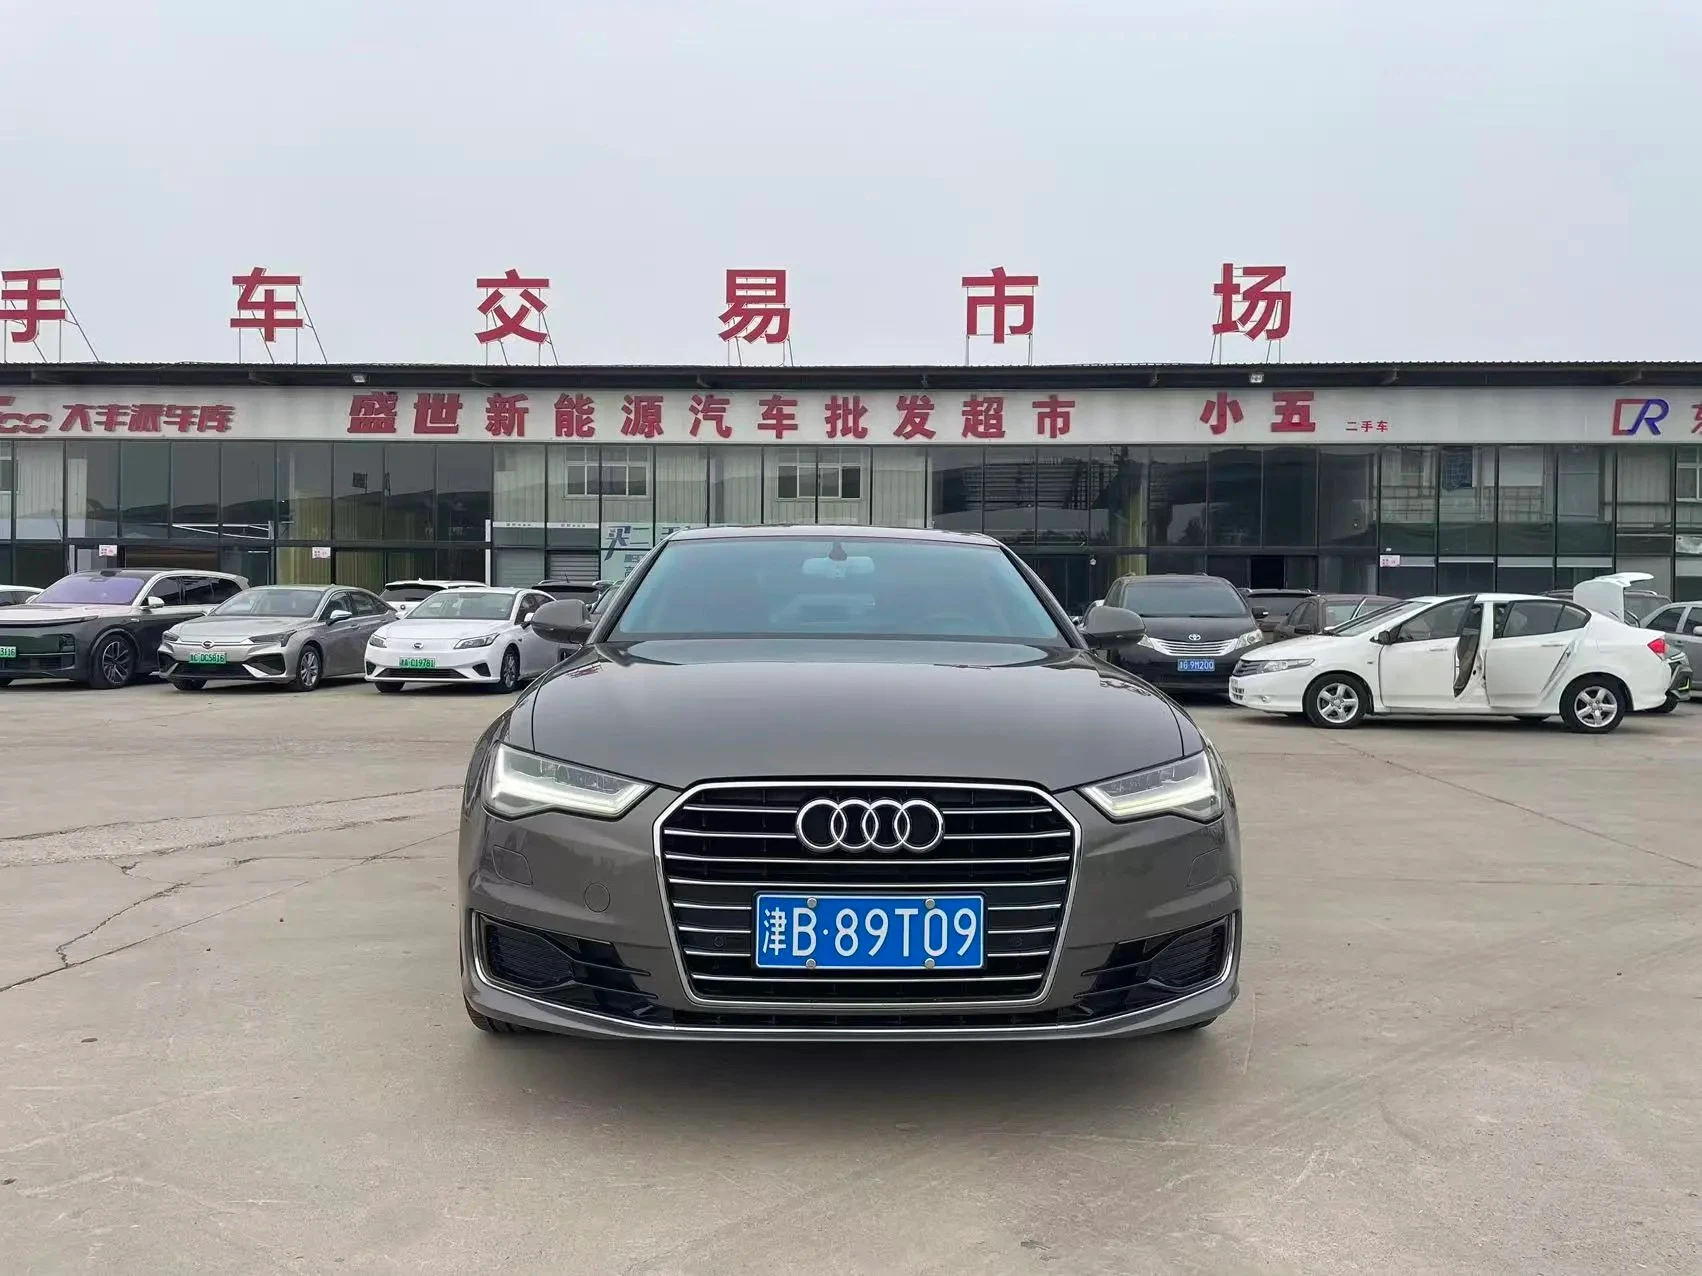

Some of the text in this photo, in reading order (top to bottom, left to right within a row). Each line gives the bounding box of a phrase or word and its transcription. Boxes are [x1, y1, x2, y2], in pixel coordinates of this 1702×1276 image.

[0, 263, 1292, 345] 手车交易市场
[347, 390, 1076, 439] 盛世新能源汽车批发超市
[1199, 391, 1317, 436] 小五
[1345, 420, 1388, 433] 二手车
[762, 906, 978, 957] 津B·89T09
